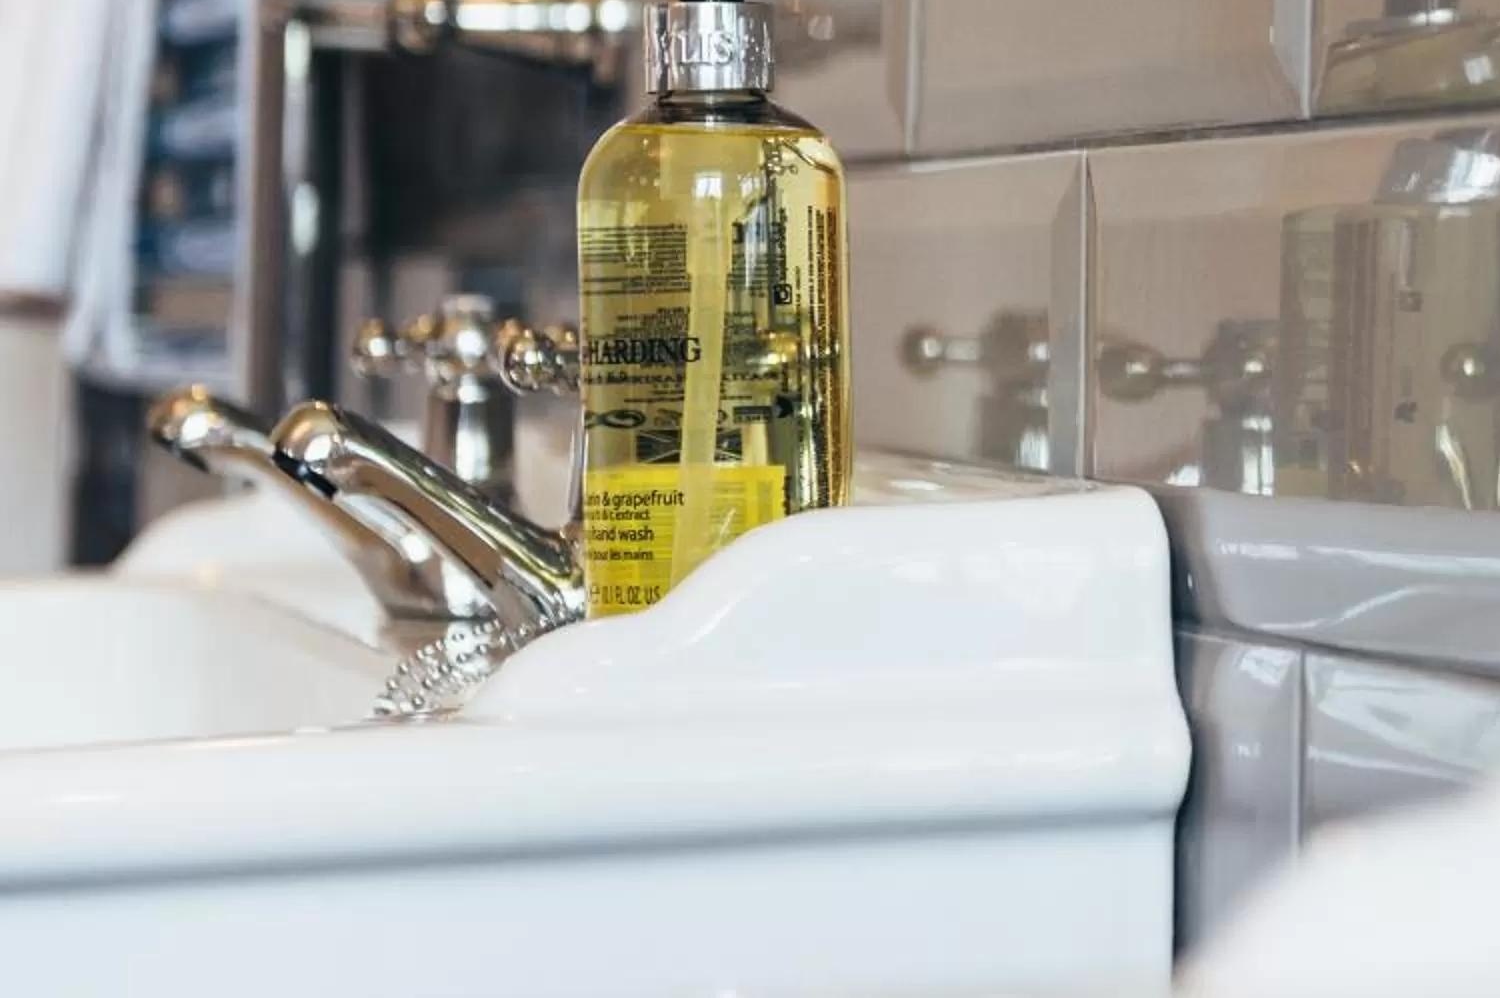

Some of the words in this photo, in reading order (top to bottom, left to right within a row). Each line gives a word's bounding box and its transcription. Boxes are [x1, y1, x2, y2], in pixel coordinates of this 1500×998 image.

[586, 337, 702, 364] HARDING
[611, 489, 686, 510] grapefruit
[618, 525, 655, 541] wash
